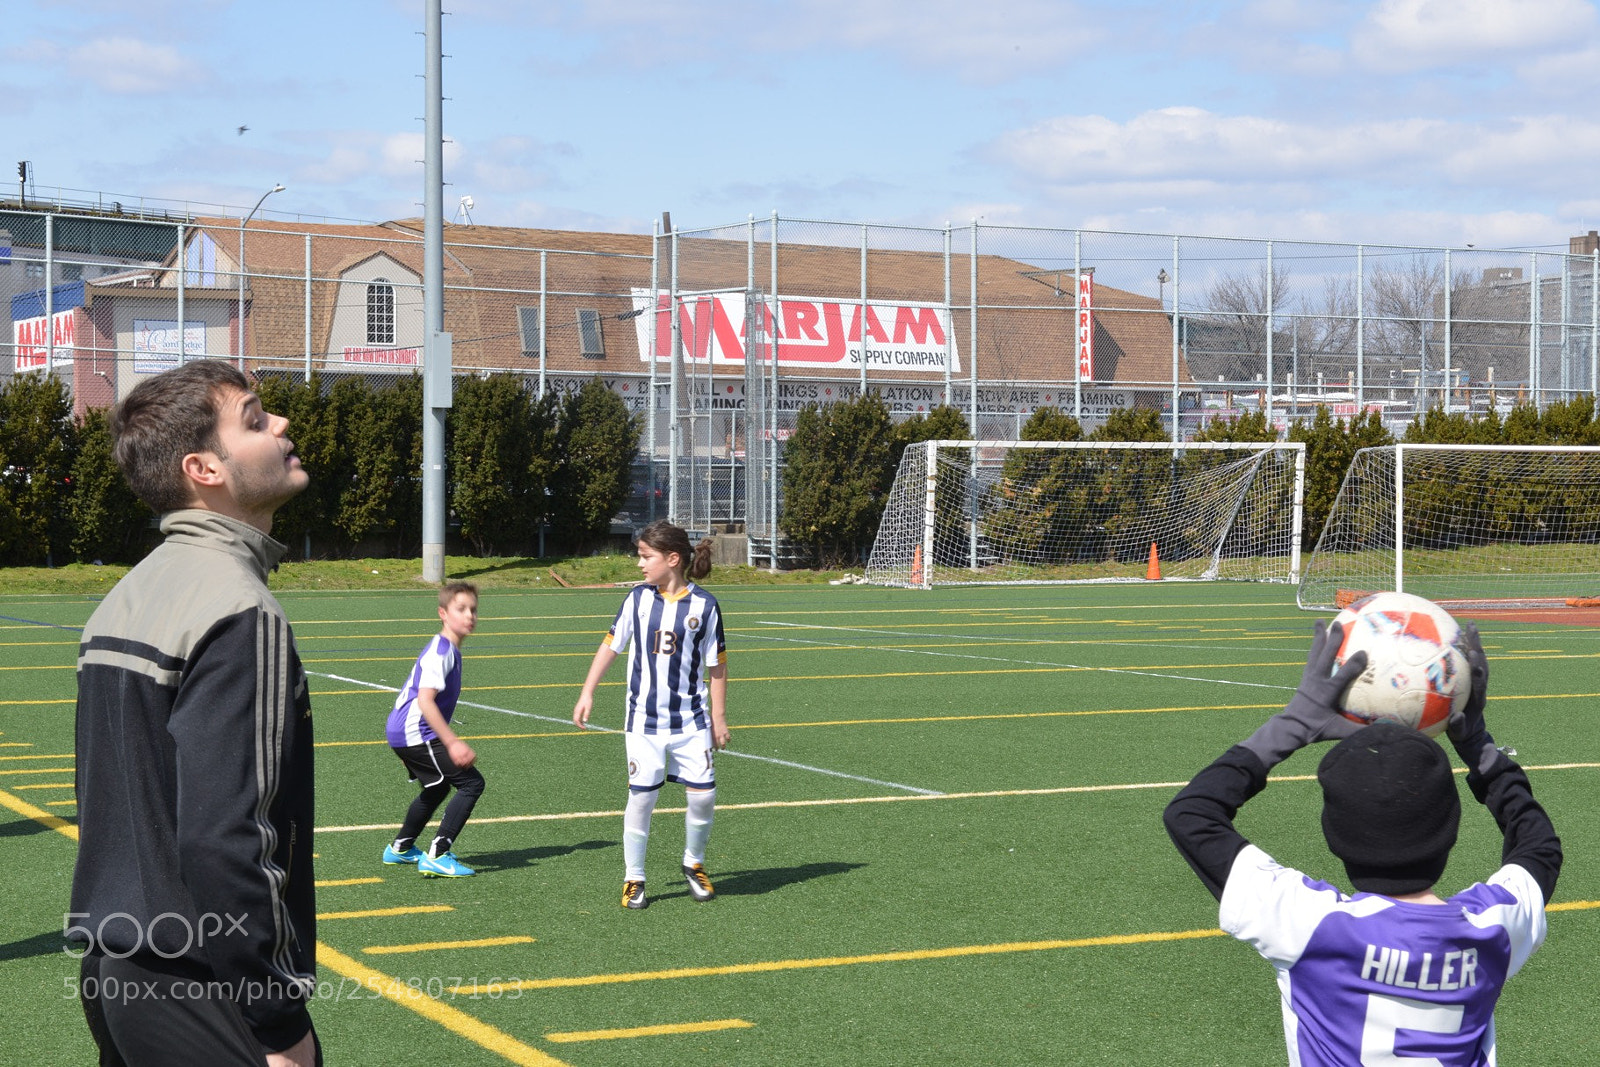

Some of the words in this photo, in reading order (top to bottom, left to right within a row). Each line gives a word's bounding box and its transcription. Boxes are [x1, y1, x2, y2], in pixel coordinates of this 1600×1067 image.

[649, 294, 946, 363] MARJAM
[1080, 280, 1090, 377] MARJAM
[895, 351, 948, 366] COMPAN
[524, 379, 615, 392] MASOY
[839, 386, 933, 400] INSUATION
[1058, 392, 1125, 405] FRAMING
[652, 630, 678, 655] 13
[1361, 944, 1479, 990] HILLER
